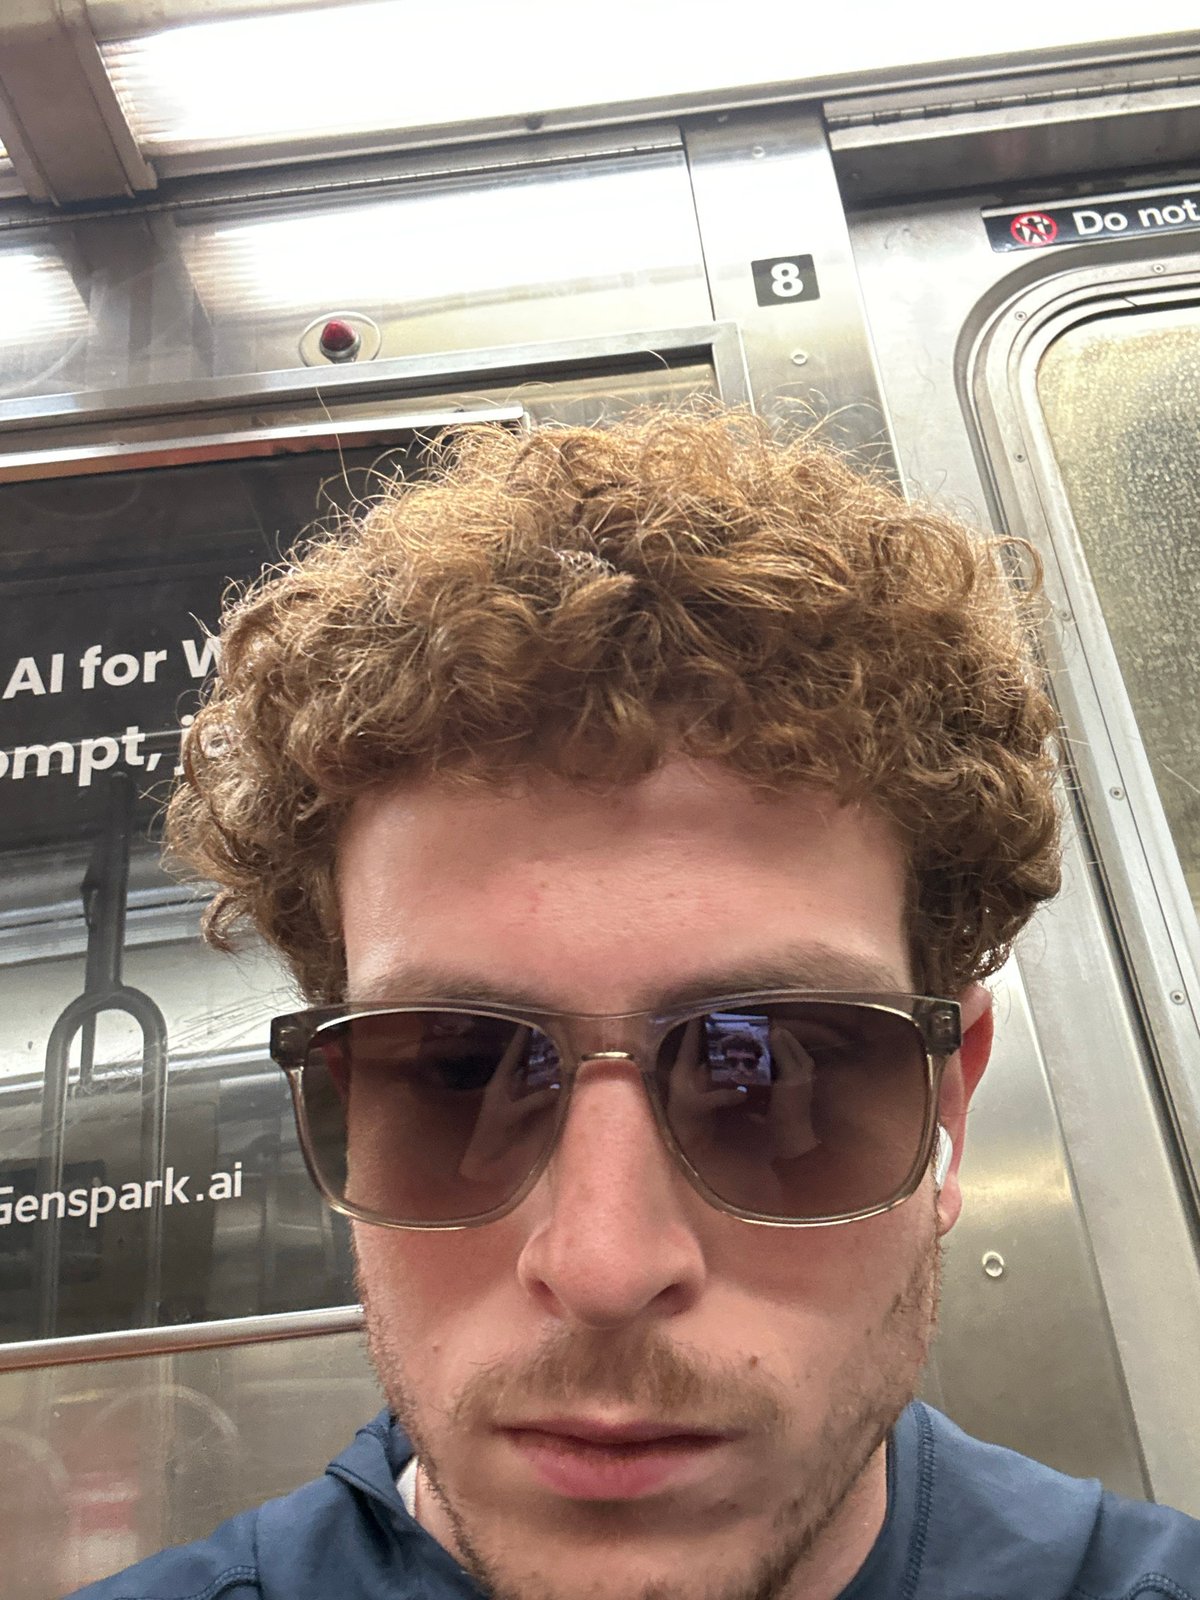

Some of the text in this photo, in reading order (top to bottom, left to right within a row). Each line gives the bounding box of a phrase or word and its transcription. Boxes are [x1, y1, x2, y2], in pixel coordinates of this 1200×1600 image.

[1071, 198, 1200, 236] Do not
[770, 262, 804, 298] 8
[2, 652, 65, 700] AI
[79, 644, 168, 691] for
[0, 725, 163, 787] mpt,
